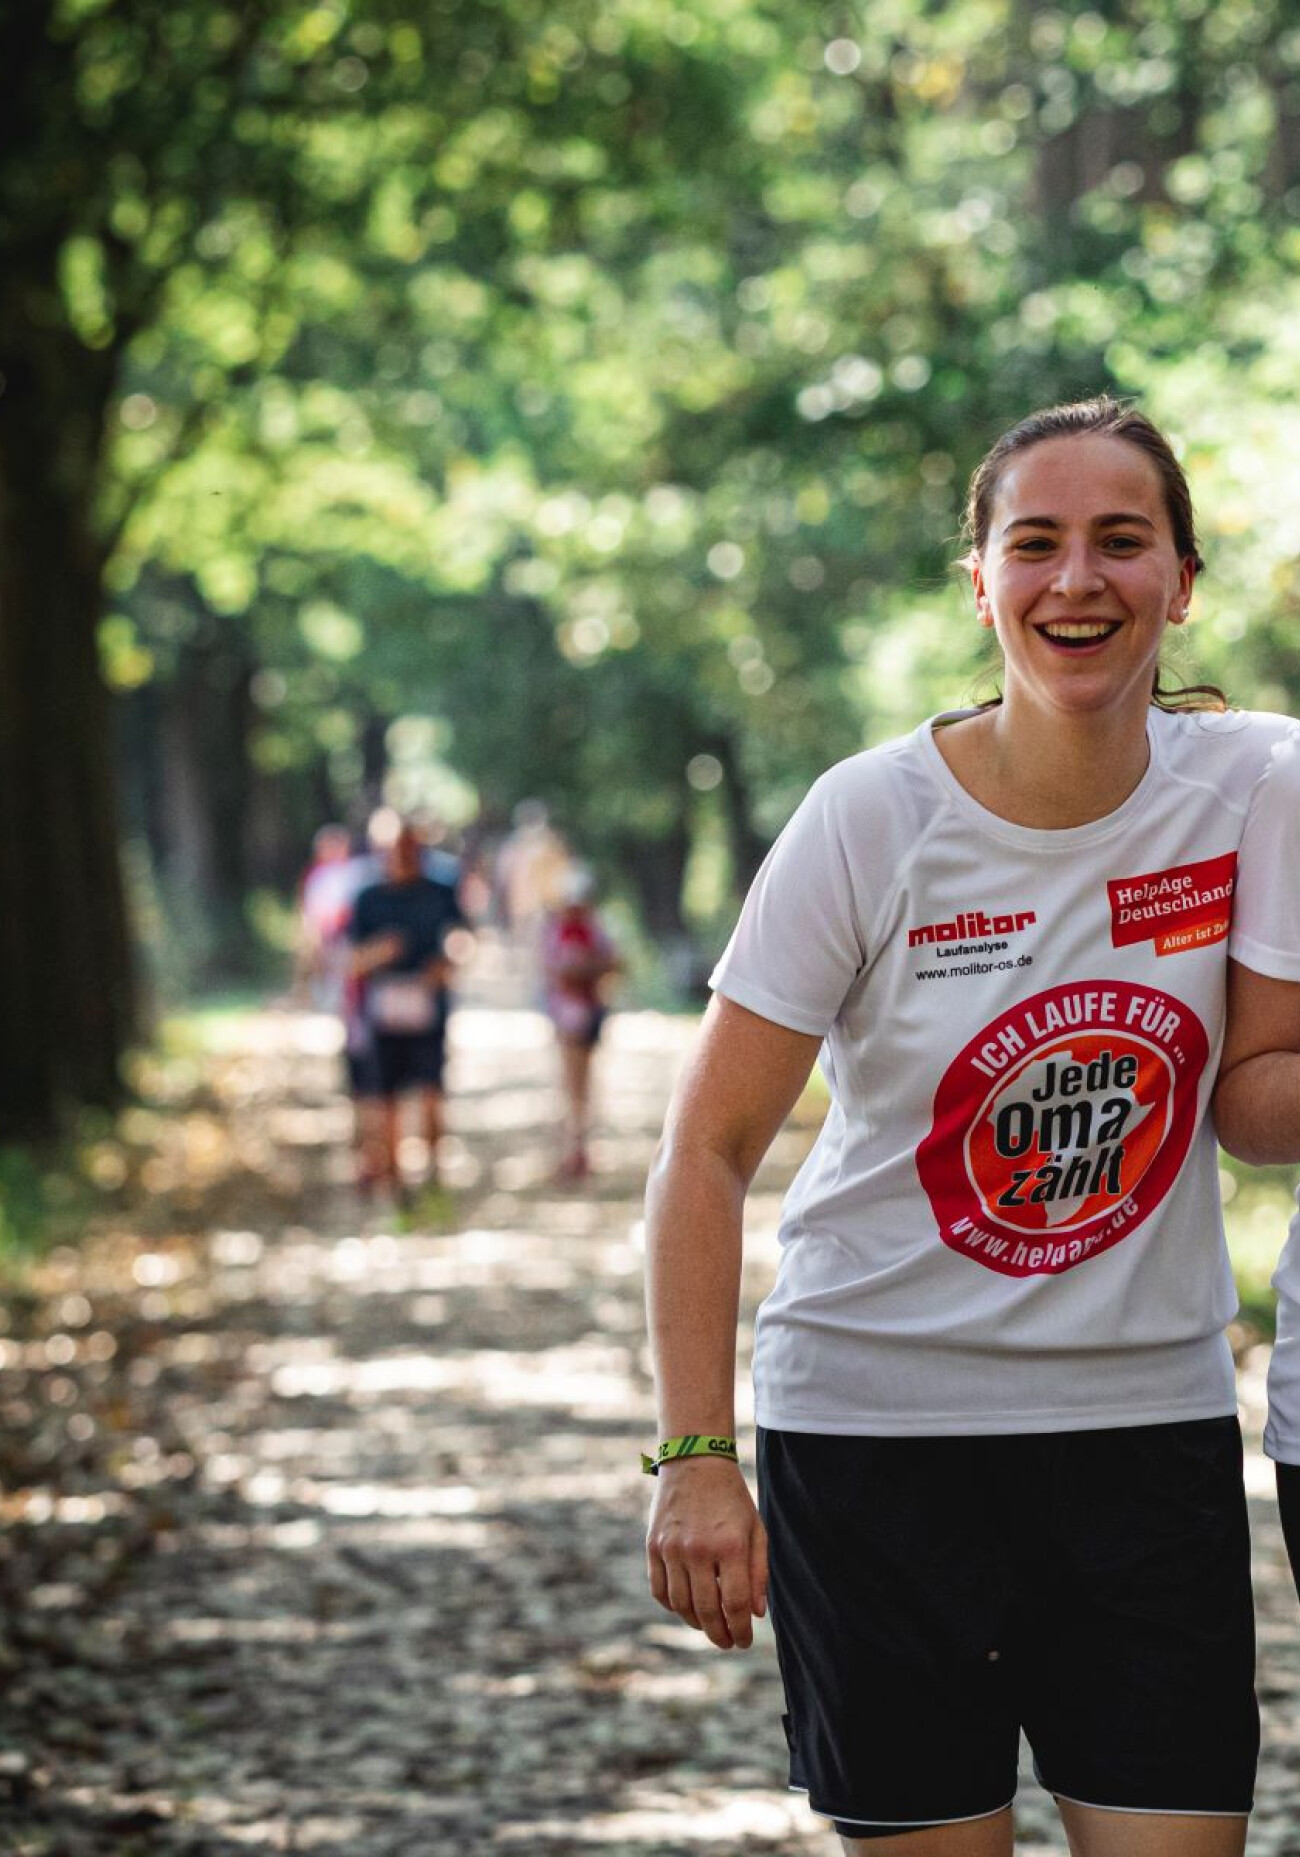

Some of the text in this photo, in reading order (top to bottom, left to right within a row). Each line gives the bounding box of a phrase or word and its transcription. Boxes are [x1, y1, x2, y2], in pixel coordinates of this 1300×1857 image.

[1116, 876, 1193, 905] HelpAge
[1118, 878, 1233, 924] Deutschland
[908, 911, 1036, 947] molitor
[936, 940, 1008, 958] Laufanalyse
[1163, 935, 1193, 950] Alter
[1196, 928, 1211, 941] ist
[915, 954, 1033, 980] www.molitor-os.de
[971, 1025, 1026, 1078] ICH
[1024, 992, 1117, 1040] LAUFE
[1032, 1051, 1137, 1103] Jede
[996, 1096, 1132, 1158] Oma
[998, 1144, 1125, 1206] zählt
